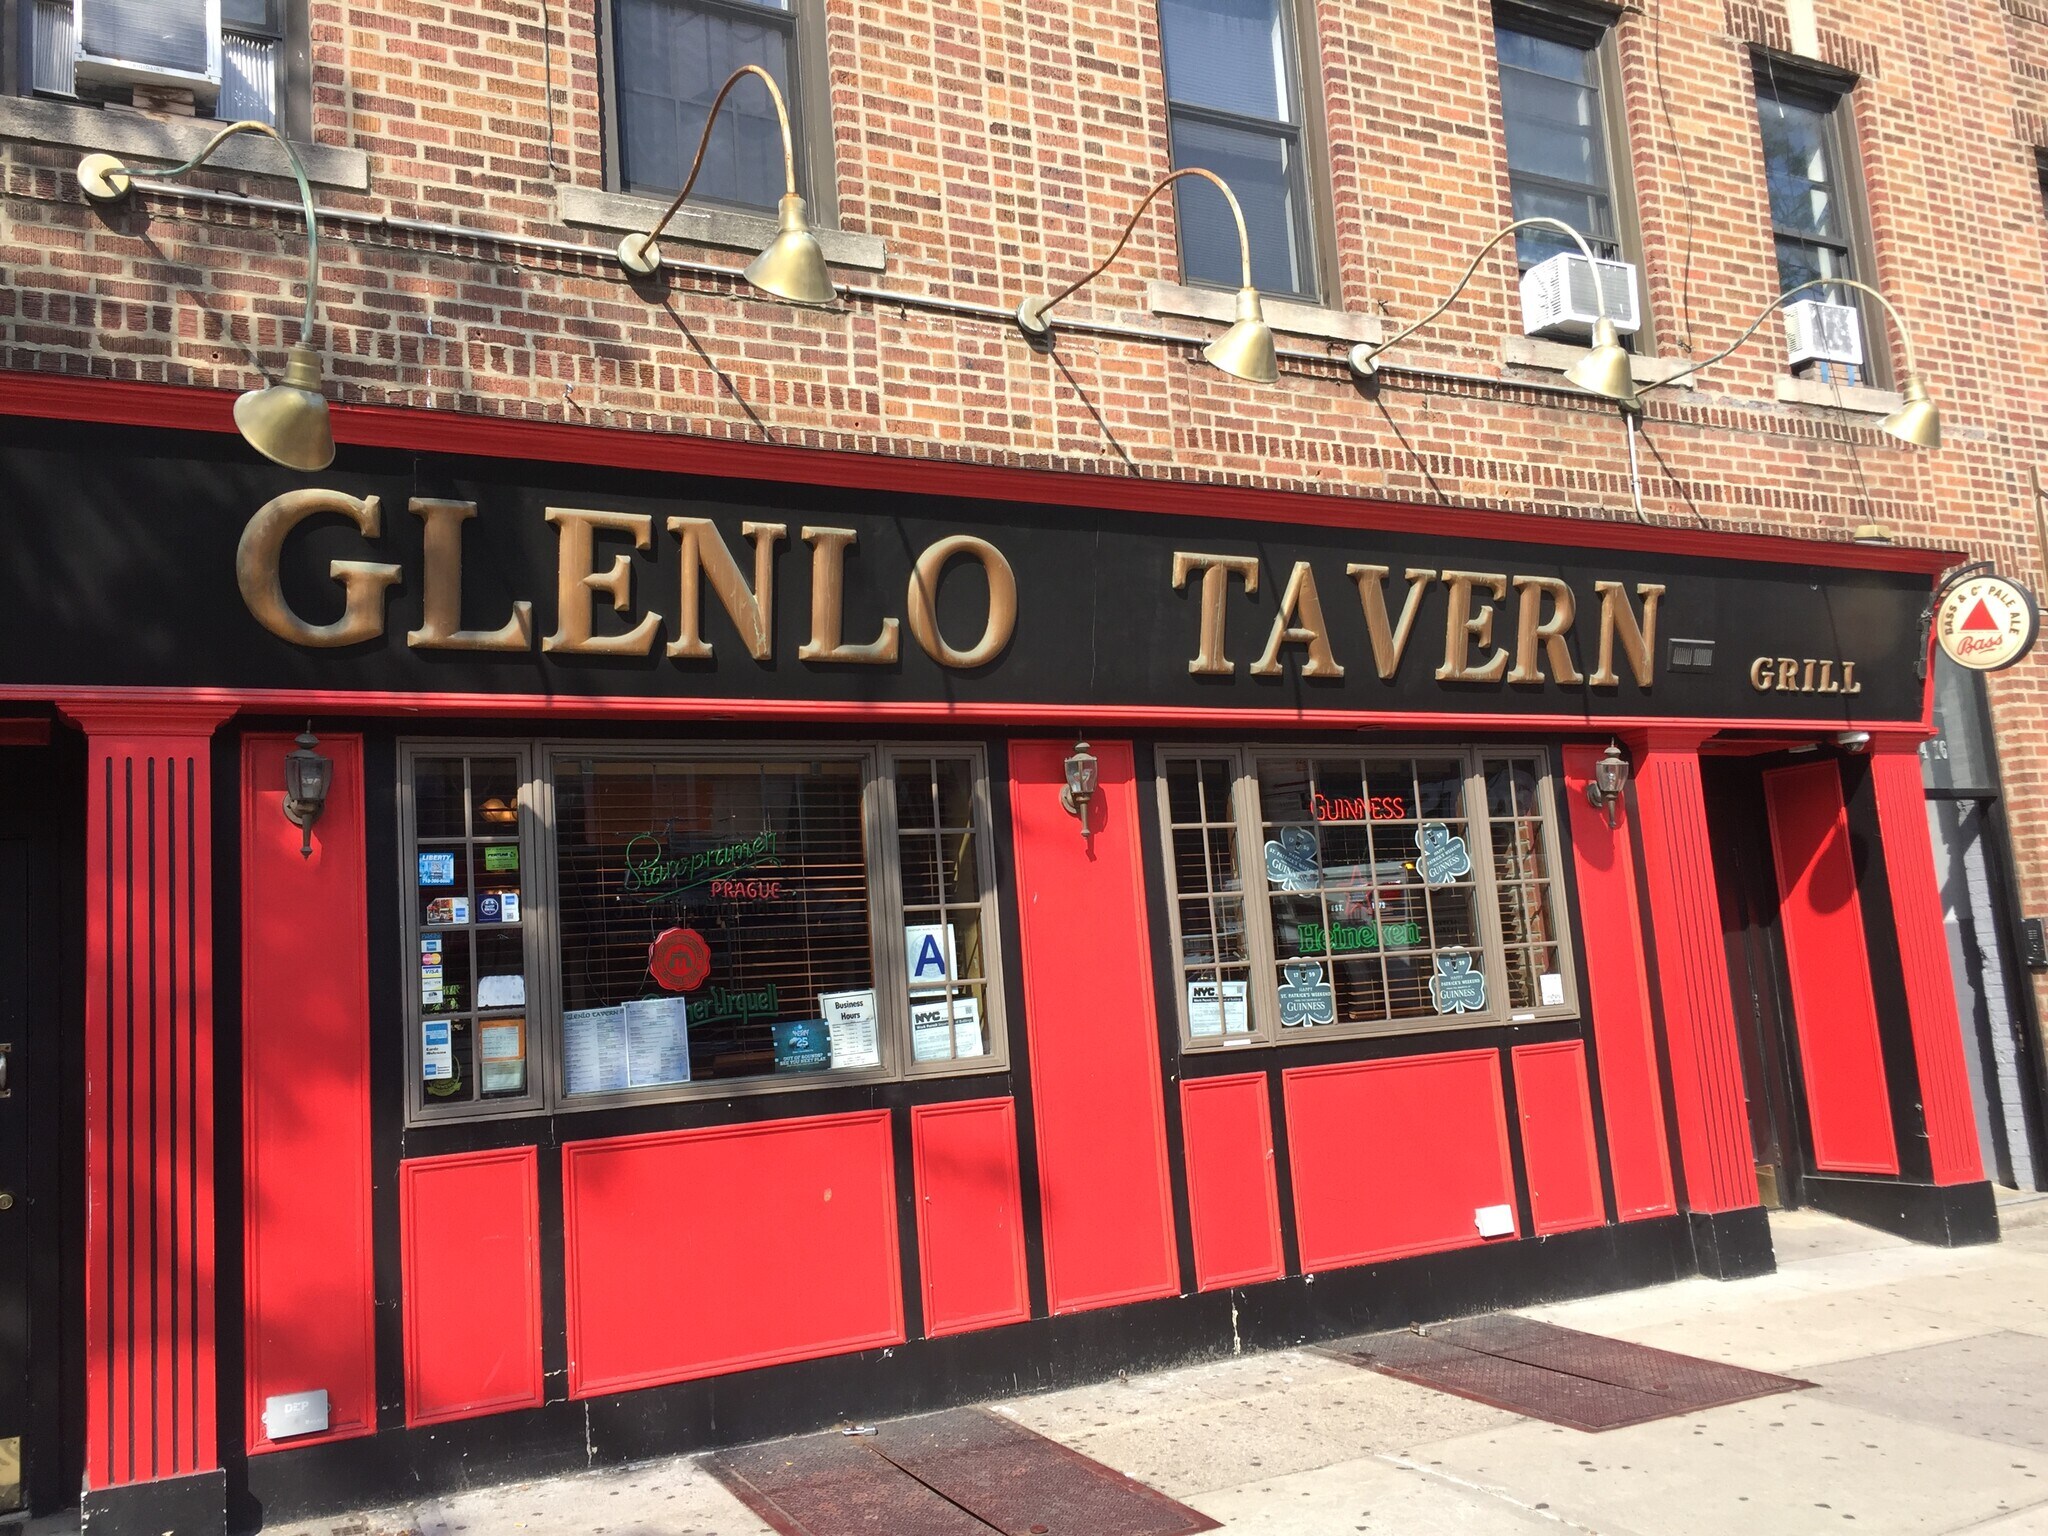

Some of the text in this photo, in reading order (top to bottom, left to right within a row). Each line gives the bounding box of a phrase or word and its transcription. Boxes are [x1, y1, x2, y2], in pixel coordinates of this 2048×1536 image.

[235, 487, 1667, 688] GLENLO TAVERN
[1944, 604, 1958, 636] BASS
[1987, 585, 2017, 608] PALE
[2008, 612, 2021, 636] ALE
[1956, 634, 2004, 656] Bass
[1750, 656, 1862, 694] GRILL
[1310, 793, 1406, 821] GUINNESS
[1428, 856, 1460, 878] GUINNESS
[710, 881, 781, 899] PRAGUE
[1371, 901, 1386, 910] 173
[1297, 919, 1422, 953] Heineken
[914, 934, 946, 977] A
[1193, 987, 1215, 996] NYC
[1440, 988, 1476, 999] GUINNESS
[711, 983, 779, 1024] Urquell
[834, 1000, 864, 1010] Business
[1286, 1001, 1326, 1012] GUINNESS
[565, 1010, 619, 1020] GLENLO TAVERN
[840, 1012, 861, 1020] Hours
[915, 1010, 941, 1024] NYC
